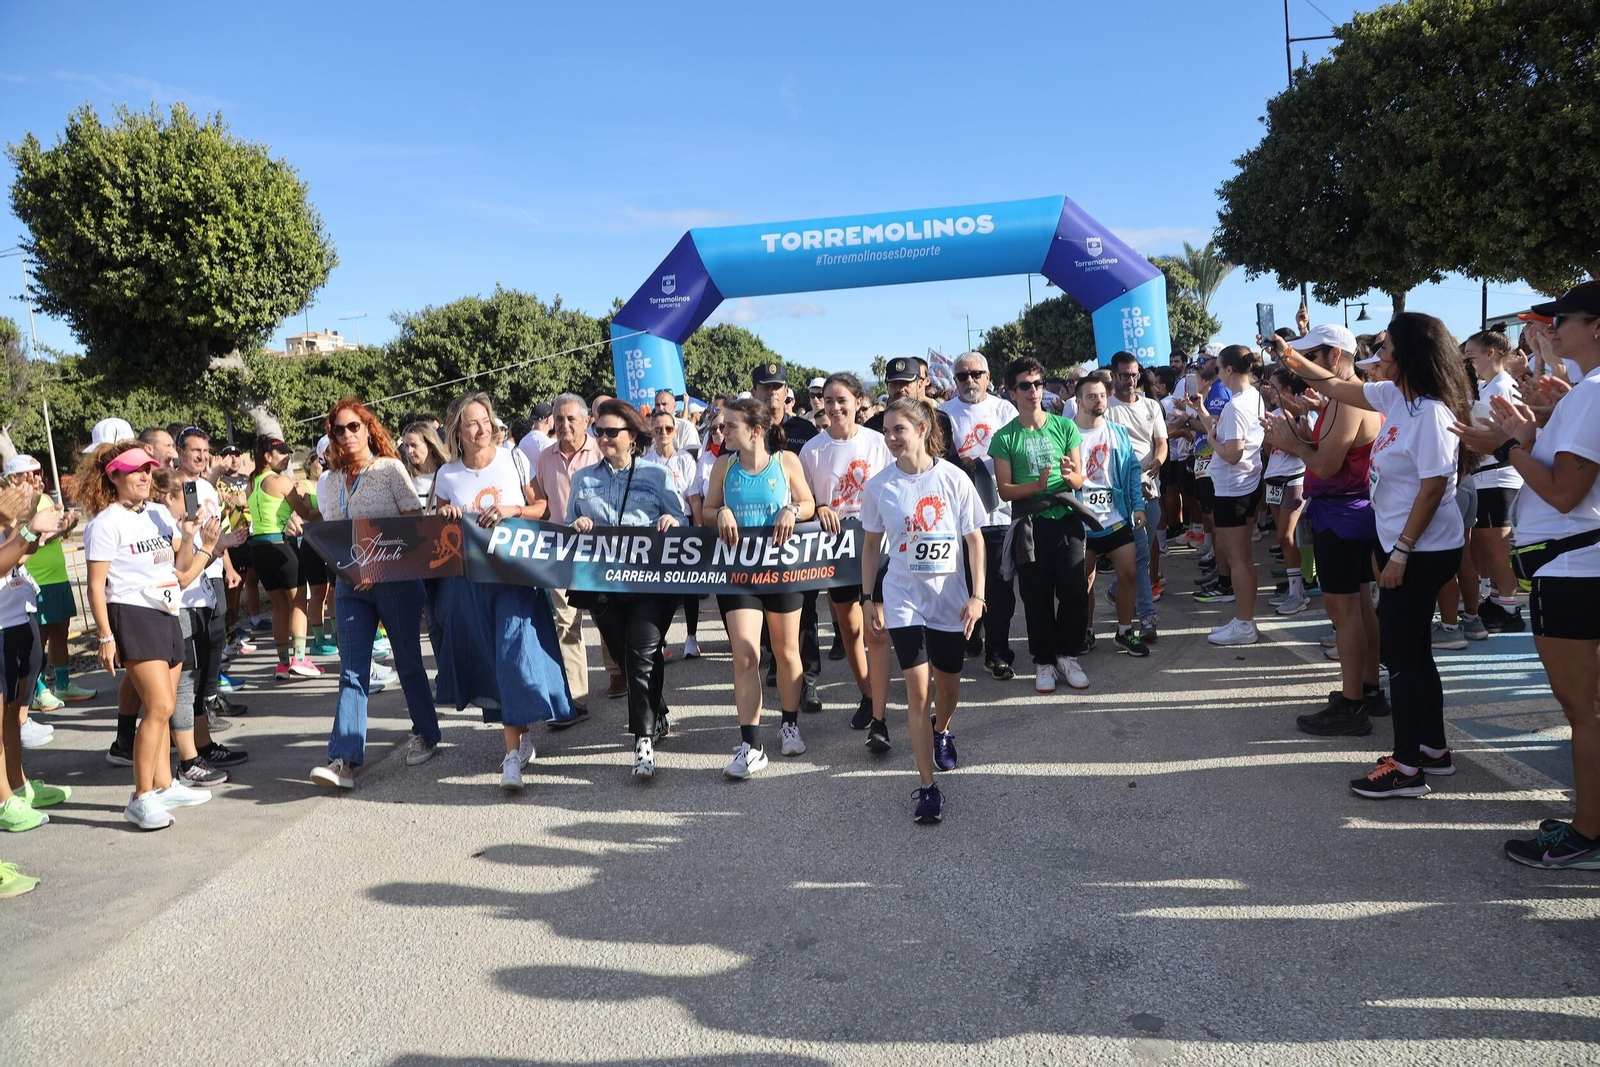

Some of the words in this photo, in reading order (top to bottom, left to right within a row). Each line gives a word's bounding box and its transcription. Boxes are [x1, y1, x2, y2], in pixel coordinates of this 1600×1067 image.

[760, 214, 995, 253] TORREMOLINOS
[815, 244, 941, 266] #TorremolinosesDeporte
[1074, 258, 1118, 268] Torremolinos
[649, 295, 691, 305] Torremolinos
[1121, 306, 1142, 318] TO
[1122, 316, 1151, 329] RRE
[1123, 327, 1145, 339] MO
[1124, 338, 1138, 349] LI
[624, 349, 643, 360] TO
[626, 358, 652, 370] RRE
[626, 369, 645, 380] MO
[628, 379, 639, 390] LI
[629, 387, 656, 400] NOS
[1089, 492, 1113, 505] 953
[486, 526, 652, 565] PREVENIR
[660, 536, 703, 566] ES
[711, 529, 856, 567] NUESTRA
[914, 542, 951, 560] 952
[605, 569, 661, 583] CARRERA
[663, 570, 727, 584] SOLIDARIA
[730, 572, 748, 584] NO
[751, 570, 779, 585] MÁS
[782, 566, 836, 583] SUICIDIOS
